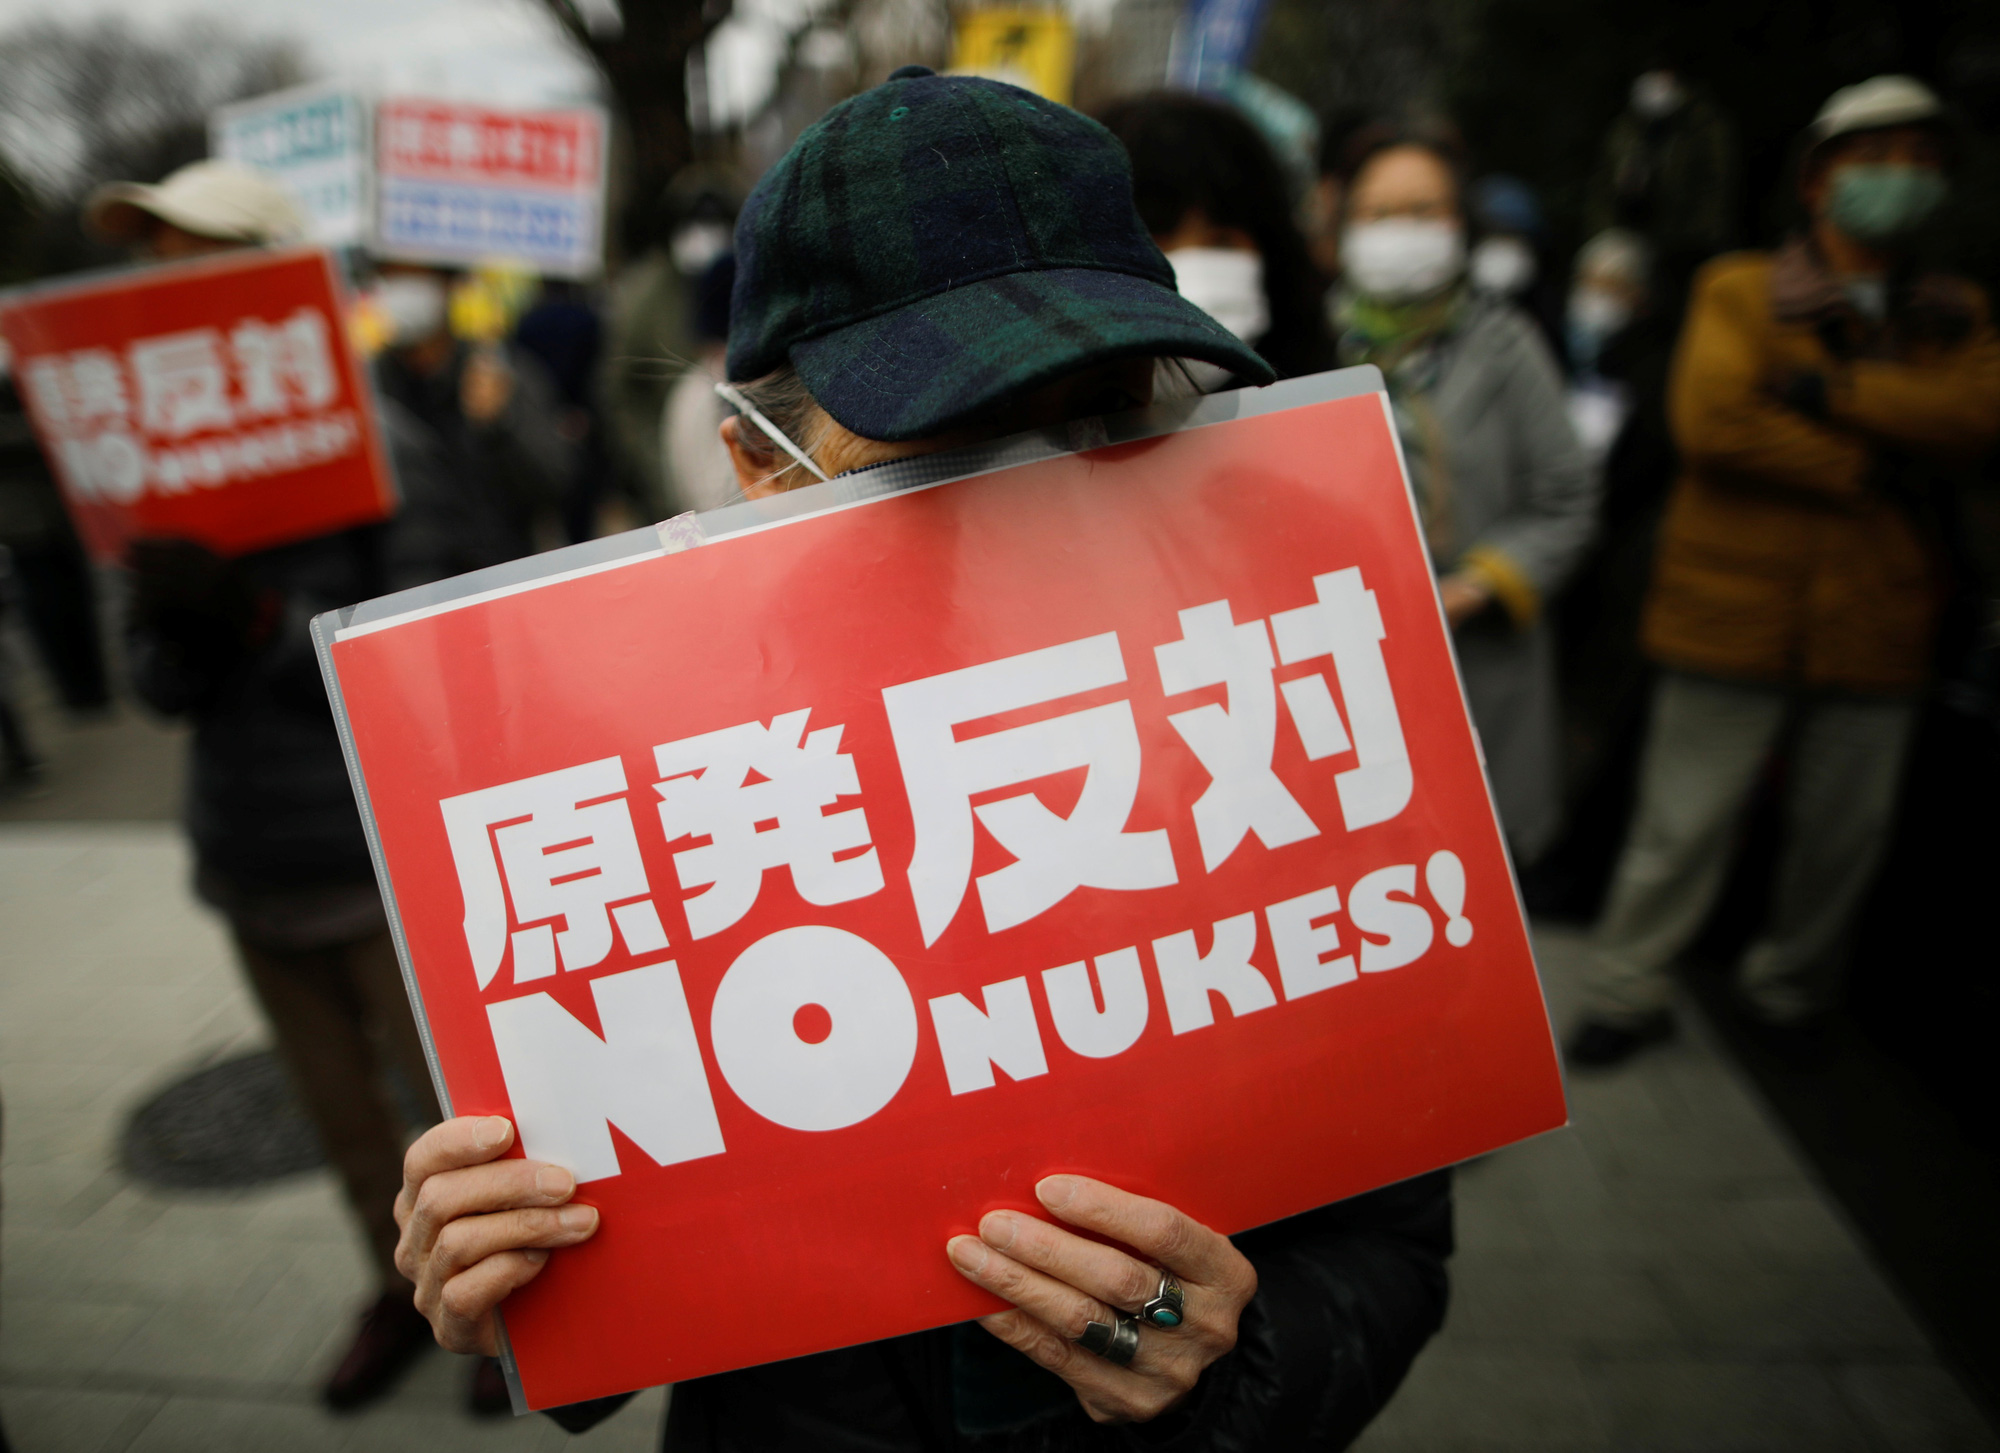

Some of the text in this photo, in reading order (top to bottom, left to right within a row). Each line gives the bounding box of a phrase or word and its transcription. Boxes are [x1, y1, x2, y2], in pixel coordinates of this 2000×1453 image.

[439, 566, 1413, 991] 原発反対
[485, 849, 1474, 1184] NO NUKES!
